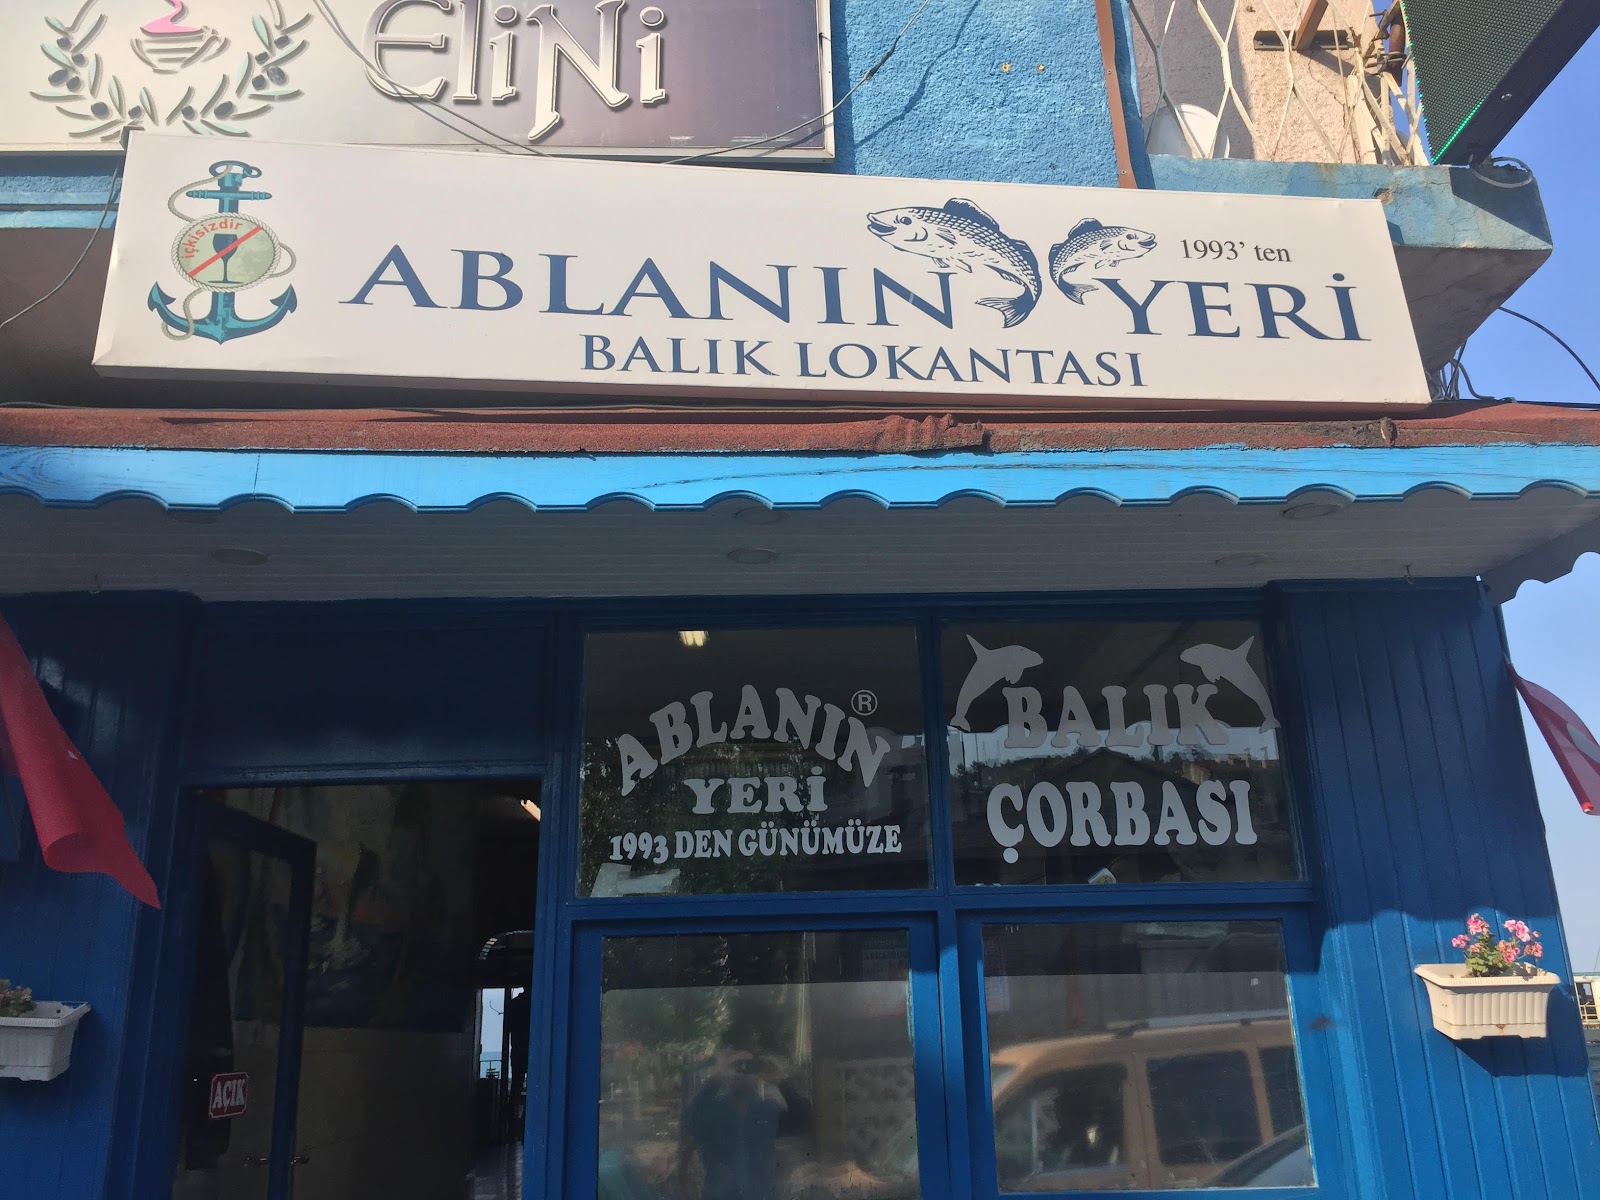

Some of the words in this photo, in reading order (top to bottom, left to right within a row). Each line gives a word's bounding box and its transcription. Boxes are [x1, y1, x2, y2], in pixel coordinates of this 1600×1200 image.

[181, 218, 243, 259] içkisizdir
[1253, 244, 1293, 263] ten
[339, 244, 957, 330] ABLANIN
[1097, 272, 1372, 342] YERİ
[584, 334, 782, 377] BALIK
[797, 342, 1149, 388] LOKANTASI
[615, 684, 891, 797] ABLANIN
[1002, 683, 1229, 749] BALIK
[684, 766, 828, 814] YERİ
[609, 832, 668, 864] 1993
[674, 829, 733, 859] DEN
[738, 818, 902, 856] GÜNÜMÜZE
[986, 779, 1258, 864] ÇORBASI
[212, 1079, 246, 1113] AÇIK
